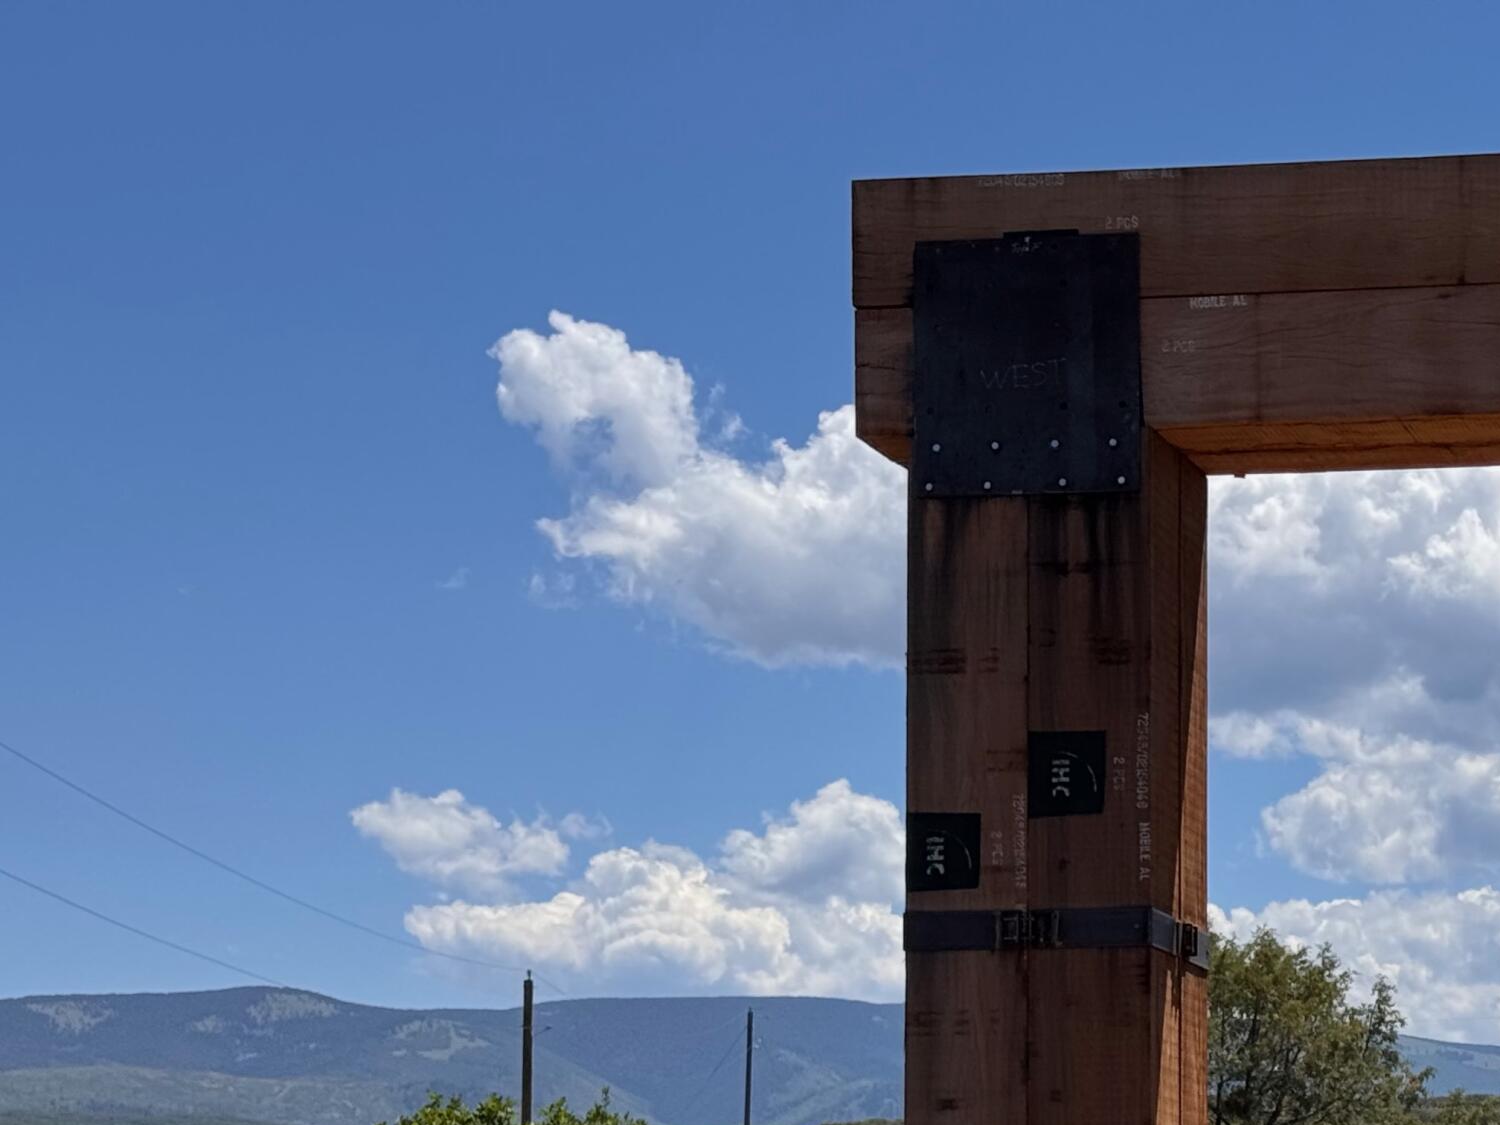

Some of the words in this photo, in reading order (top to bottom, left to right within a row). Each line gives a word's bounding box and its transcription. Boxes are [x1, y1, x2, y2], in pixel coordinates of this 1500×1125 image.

[1105, 216, 1112, 230] 2
[979, 357, 1067, 390] WEST
[1113, 756, 1125, 765] 2
[1051, 758, 1071, 798] IHC
[926, 835, 945, 876] IHC
